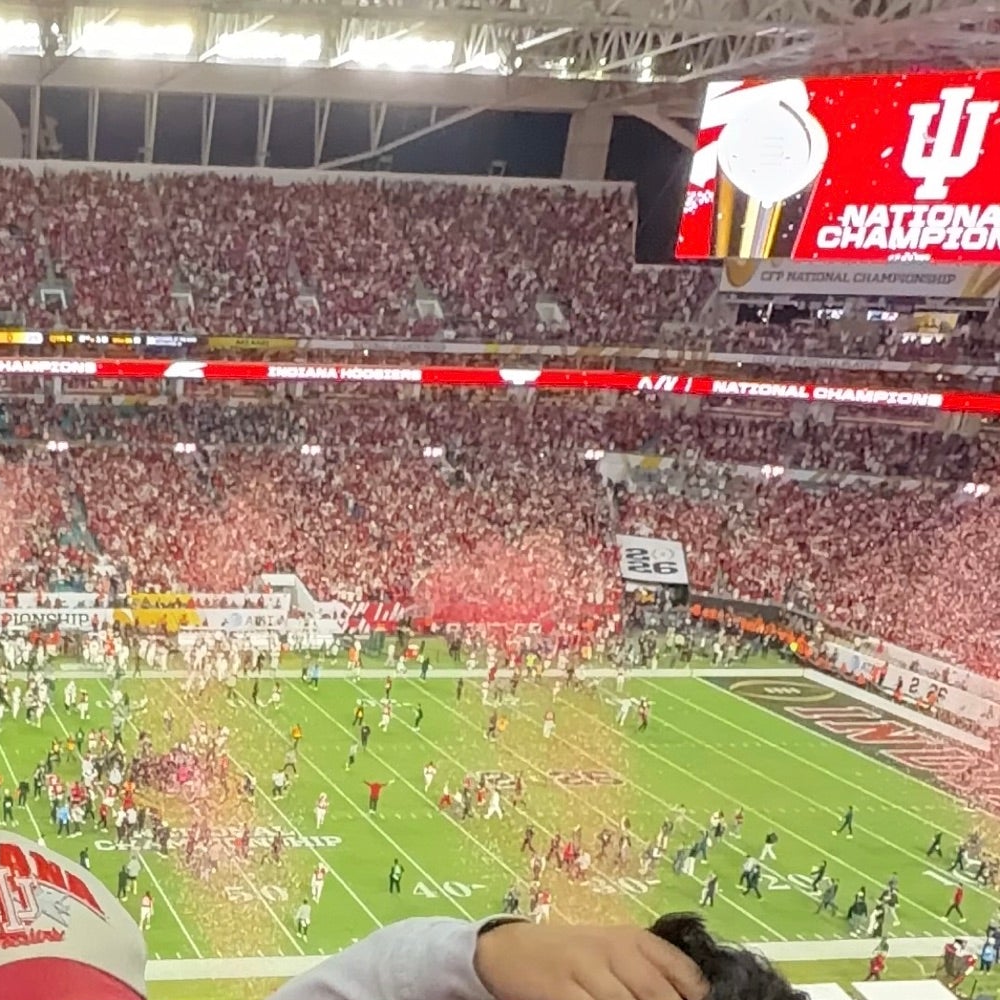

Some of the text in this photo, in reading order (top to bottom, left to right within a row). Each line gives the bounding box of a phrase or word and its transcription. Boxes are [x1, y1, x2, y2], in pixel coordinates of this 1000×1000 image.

[760, 270, 957, 285] CFP NATIONAL CHAMPIONSHIP
[712, 380, 944, 407] NATIONAL CHAMPIONS
[413, 881, 472, 898] 40
